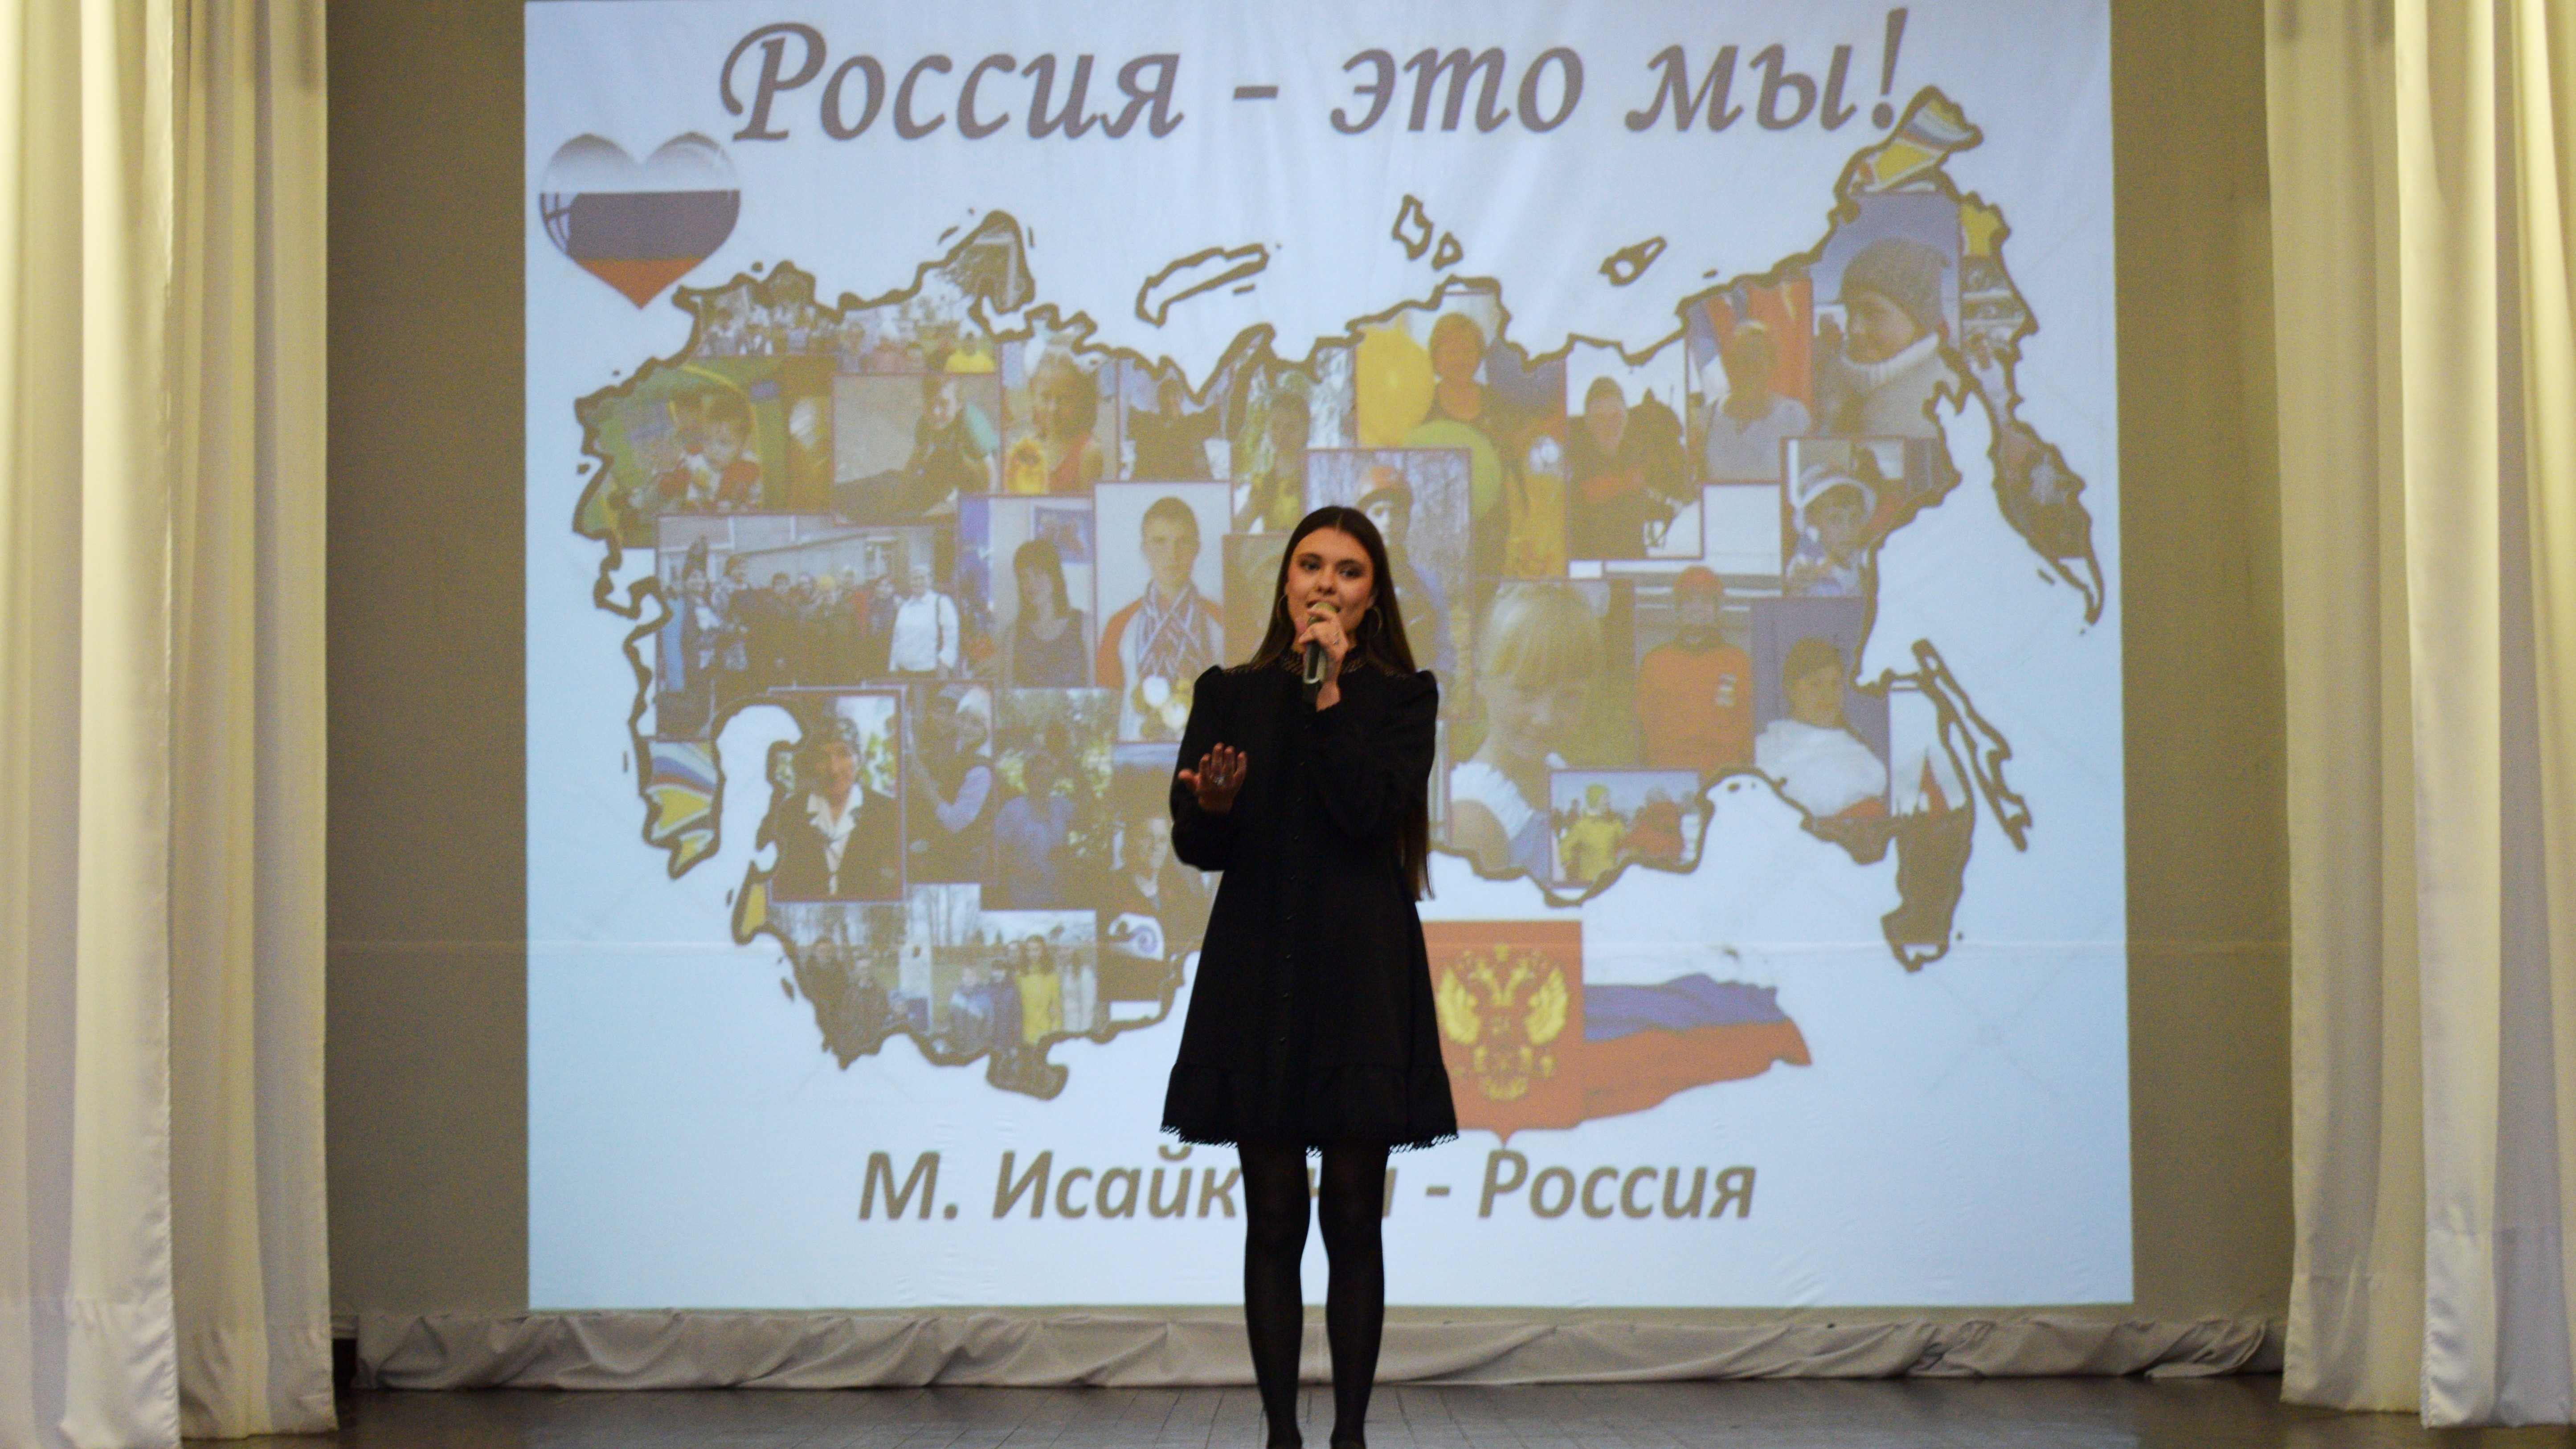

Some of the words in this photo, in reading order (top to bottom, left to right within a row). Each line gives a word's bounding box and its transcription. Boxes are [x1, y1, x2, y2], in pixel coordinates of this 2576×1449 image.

[720, 22, 1183, 142] Россия
[1233, 85, 1279, 101] -
[1330, 46, 1584, 135] это
[1624, 5, 1911, 133] мы!
[858, 1151, 958, 1221] М.
[992, 1144, 1398, 1220] Исайк
[1426, 1186, 1451, 1197] -
[1478, 1149, 1757, 1220] Россия
